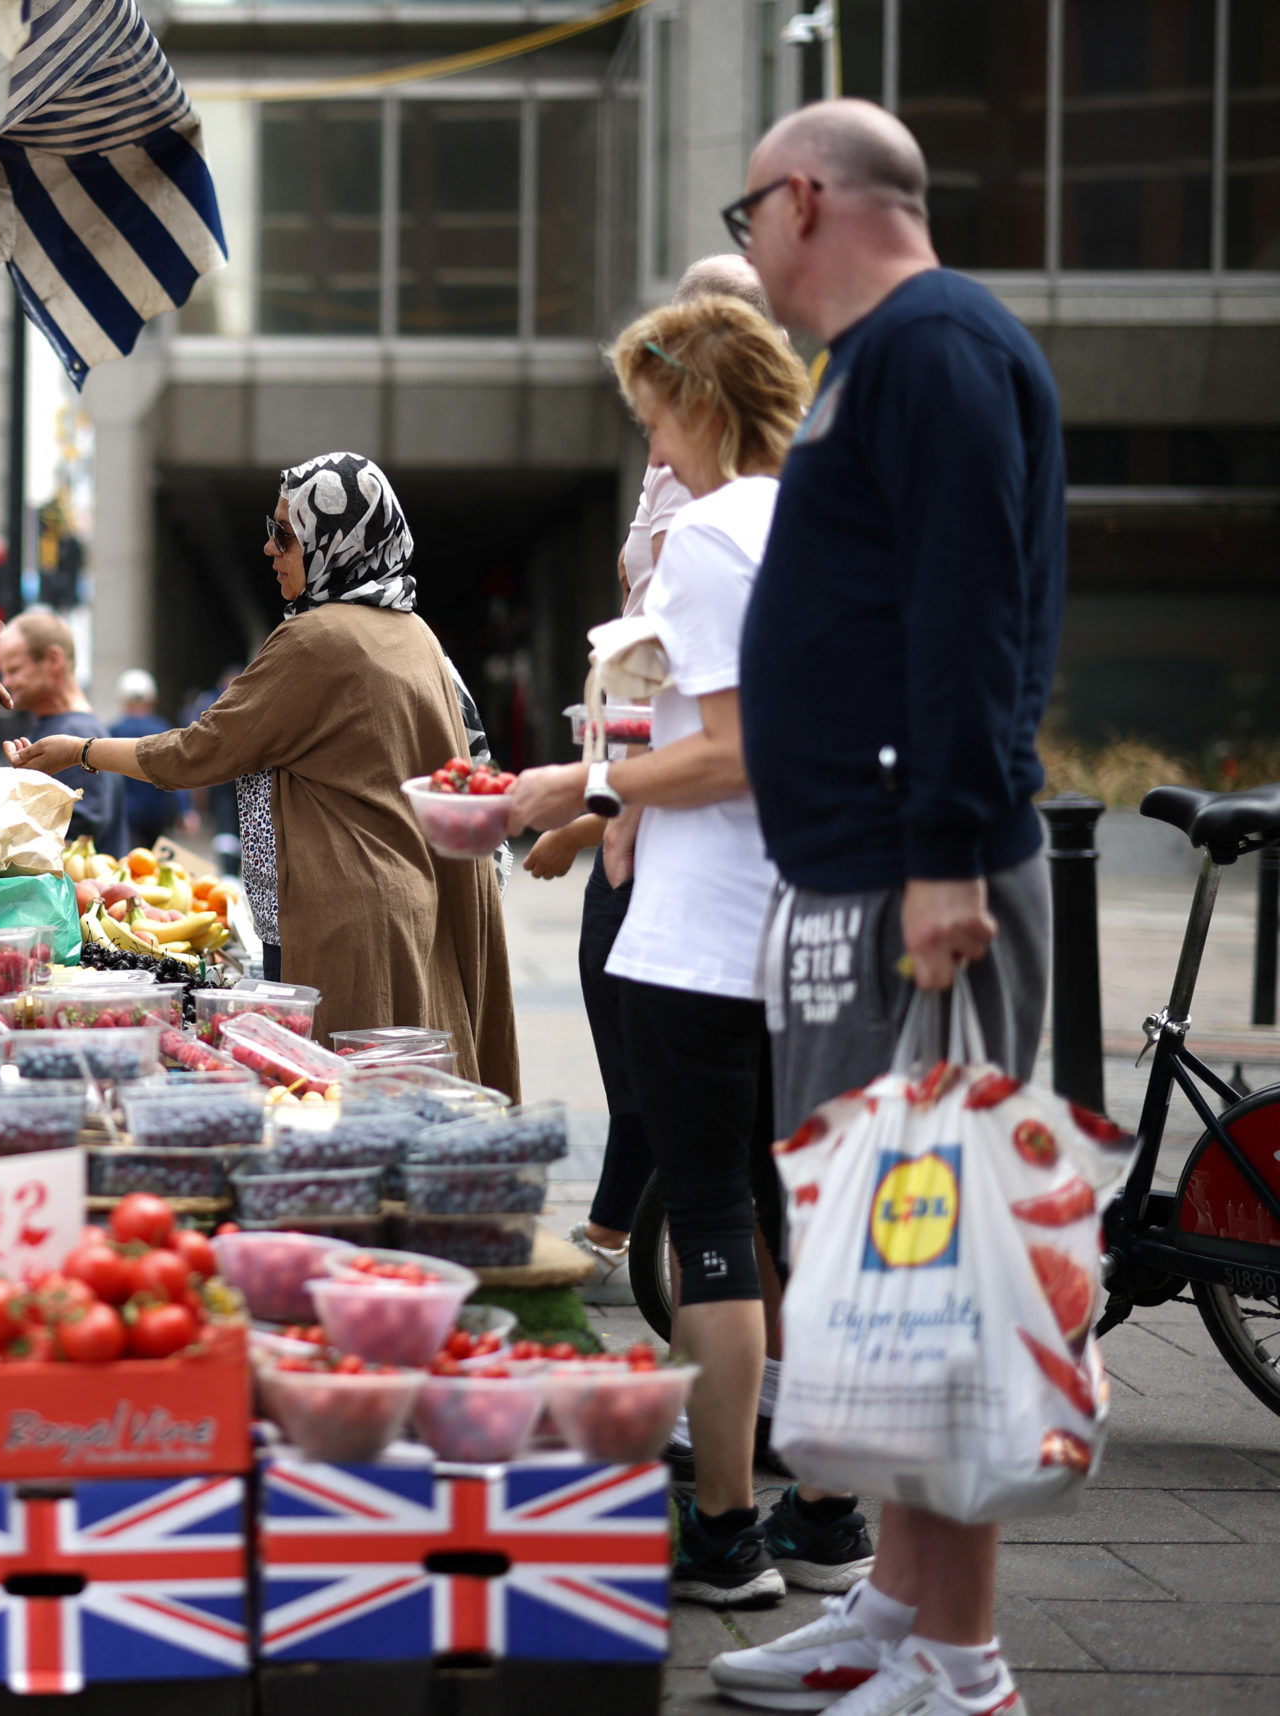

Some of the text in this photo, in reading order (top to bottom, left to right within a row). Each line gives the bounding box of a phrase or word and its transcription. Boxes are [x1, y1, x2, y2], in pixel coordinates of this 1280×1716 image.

[789, 943, 852, 980] STER
[1224, 1267, 1277, 1294] 51890
[3, 1398, 131, 1467] Royal
